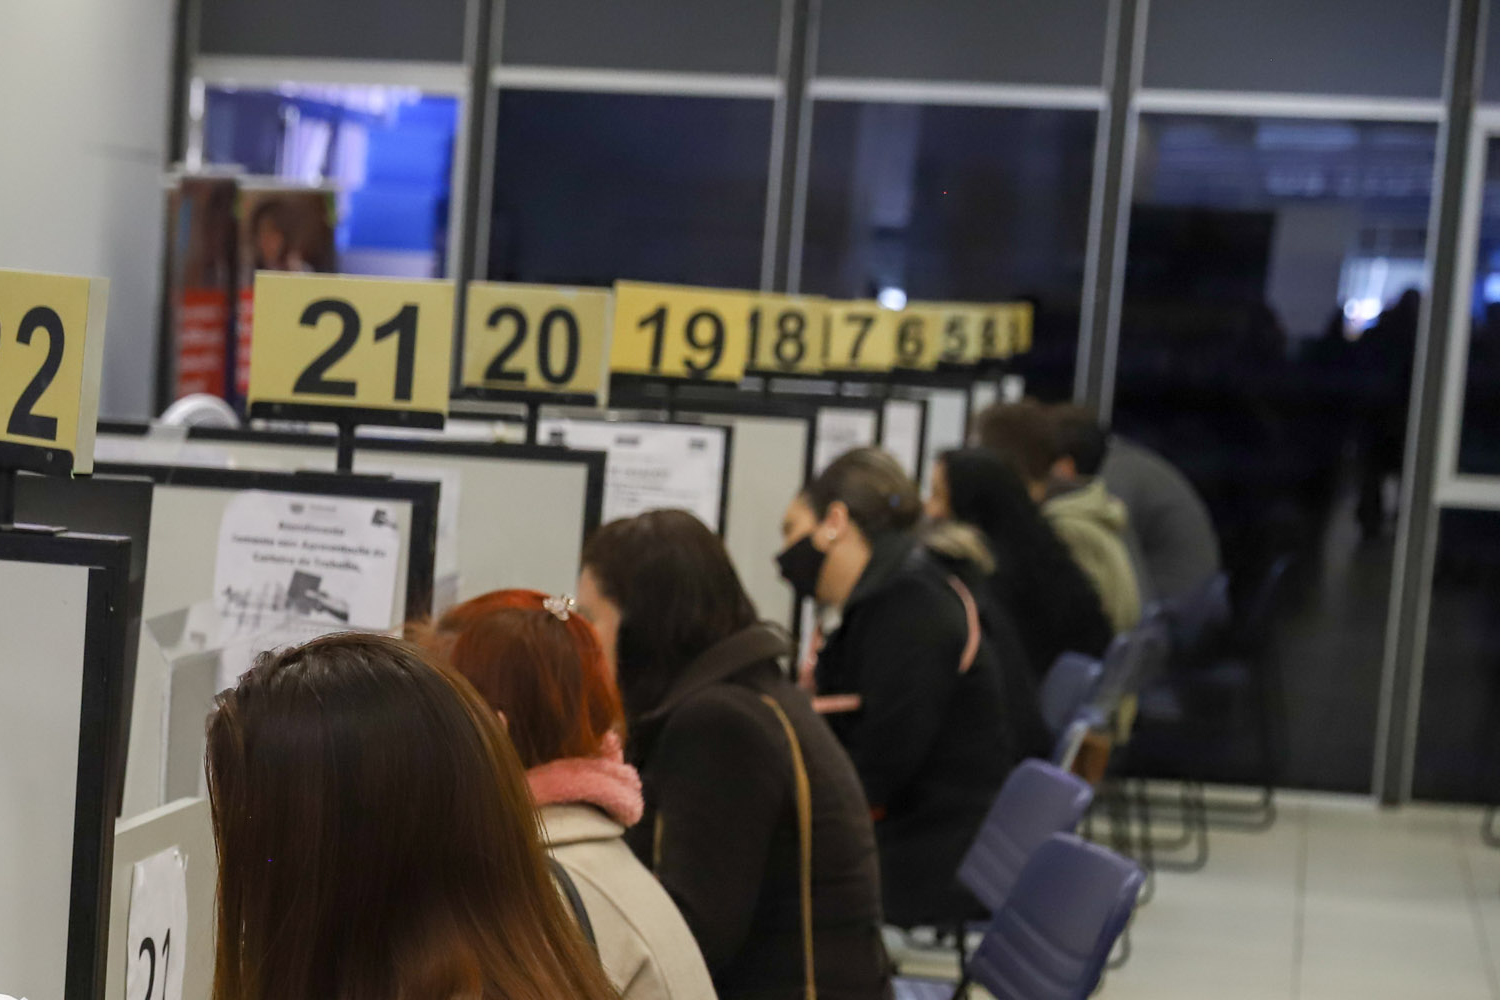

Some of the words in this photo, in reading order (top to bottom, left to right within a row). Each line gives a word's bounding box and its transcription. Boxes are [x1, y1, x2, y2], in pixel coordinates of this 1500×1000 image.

[293, 297, 419, 402] 21
[484, 304, 581, 385] 20
[637, 304, 726, 377] 19
